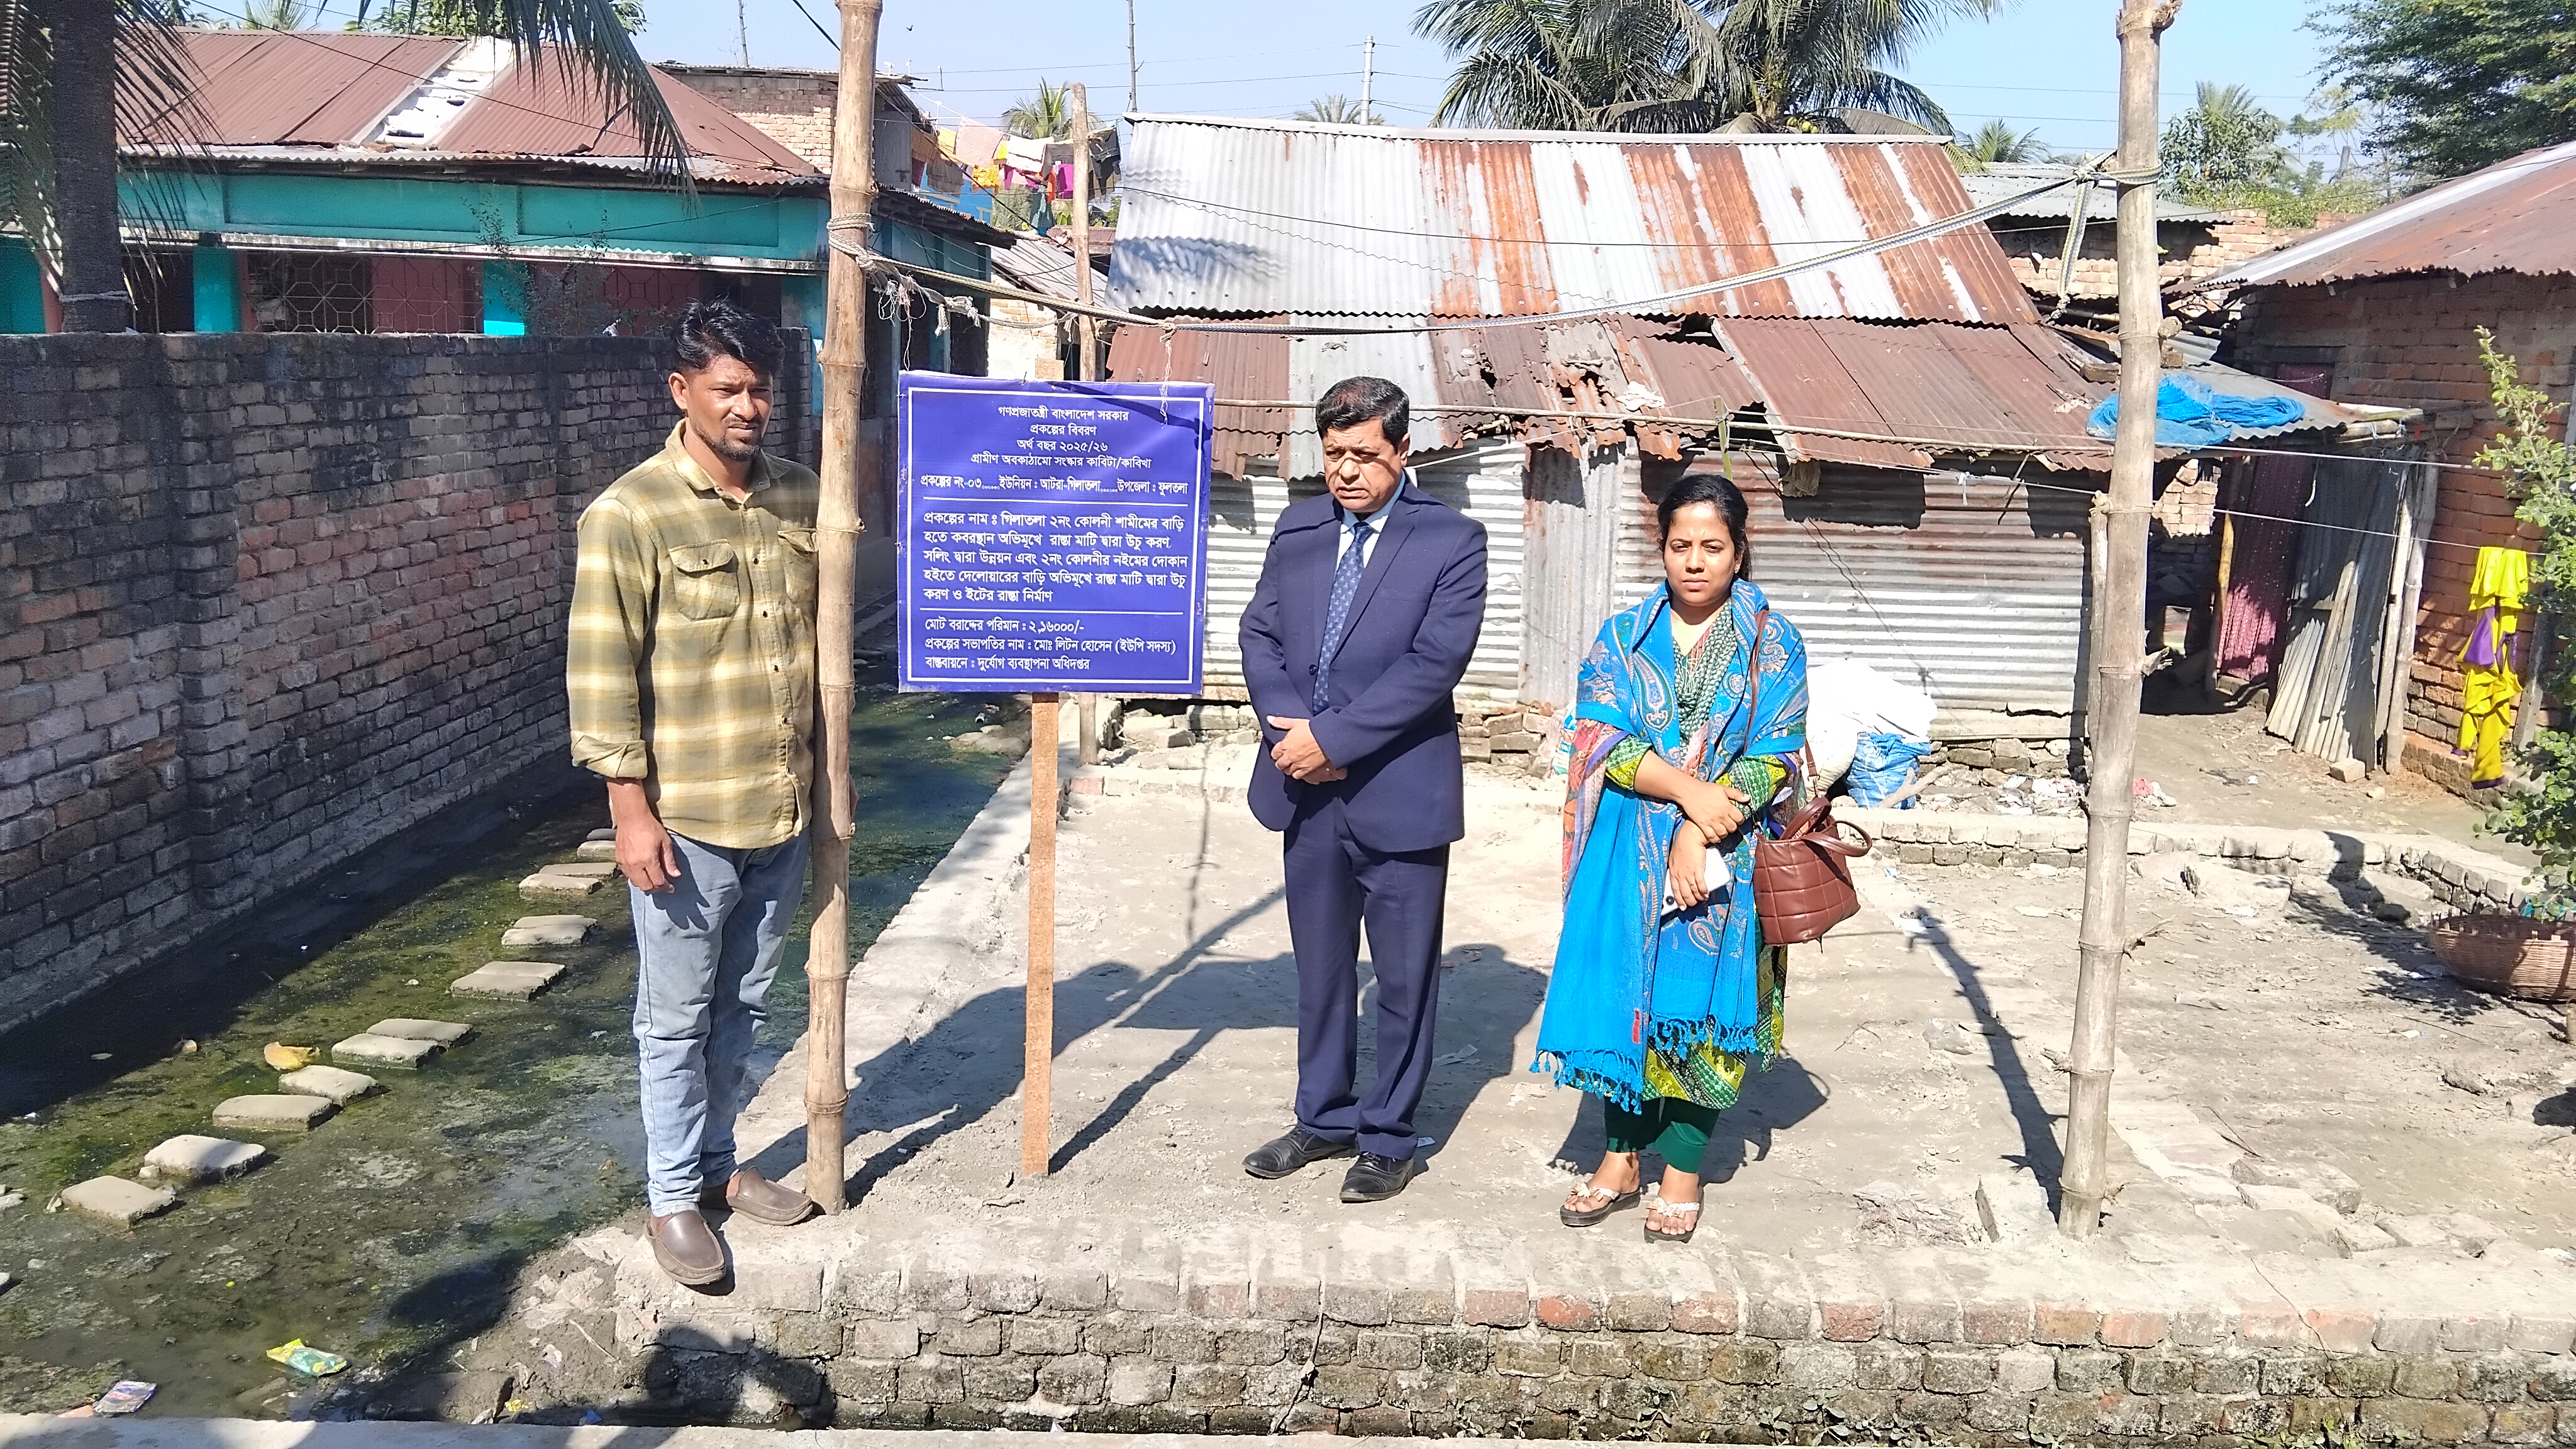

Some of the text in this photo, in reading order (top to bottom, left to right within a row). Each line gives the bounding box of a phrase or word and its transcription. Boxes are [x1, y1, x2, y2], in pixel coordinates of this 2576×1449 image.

[1050, 409, 1096, 420] বাংলাদেশ
[1097, 410, 1130, 421] সরকার
[1030, 422, 1097, 436] প্রকল্পের বিবরণ
[1016, 436, 1108, 453] অর্থ বছর ২০২৫/২৬
[970, 450, 1152, 470] গ্রামীণ অবকাঠামো সংস্কার কাবিটা/কাবিখা
[920, 474, 952, 488] প্রকল্পের
[1157, 482, 1189, 497] ফুলতলা
[923, 511, 966, 525] প্রকল্পের
[967, 513, 989, 525] নাম
[1000, 510, 1047, 527] গিলাতলা
[1050, 516, 1072, 528] ২নং
[1074, 513, 1113, 528] কোলনী
[1114, 513, 1159, 530] শামীমের
[923, 531, 948, 543] হতে
[950, 531, 996, 547] কবরস্থান
[1049, 534, 1073, 547] রাস্তা
[1074, 531, 1099, 547] মাটি
[1099, 535, 1123, 548] দ্বারা
[1124, 532, 1143, 552] উচু
[923, 547, 951, 564] সলিং
[953, 551, 977, 564] দ্বারা
[1015, 553, 1038, 565] এবং
[1041, 553, 1063, 566] ২নং
[1065, 550, 1111, 566] কোলনীর
[1113, 552, 1150, 567] নইমের
[1152, 555, 1189, 568] দোকান
[923, 566, 957, 582] হইতে
[1094, 573, 1118, 585] রাস্তা
[1119, 570, 1144, 586] মাটি
[1145, 574, 1168, 586] দ্বারা
[1169, 571, 1187, 589] উচু
[923, 586, 1054, 602] করণ ও ইটের রাস্তা নির্মাণ
[925, 615, 947, 630] মোট
[948, 619, 984, 631] বরাদ্দের
[986, 616, 1020, 631] পরিমান
[924, 637, 960, 650] প্রকল্পের
[962, 635, 1006, 650] সভাপতির
[1007, 639, 1025, 650] নাম
[1033, 640, 1053, 651] মোঃ
[1054, 636, 1079, 652] লিটন
[1080, 640, 1113, 652] হোসেন
[1115, 637, 1145, 655] (ইউপি
[1146, 640, 1176, 655] সদস্য)
[977, 654, 1006, 672] দুর্যোগ
[1007, 657, 1050, 672] ব্যবস্থাপনা
[1052, 655, 1091, 670] অধিদপ্তর
